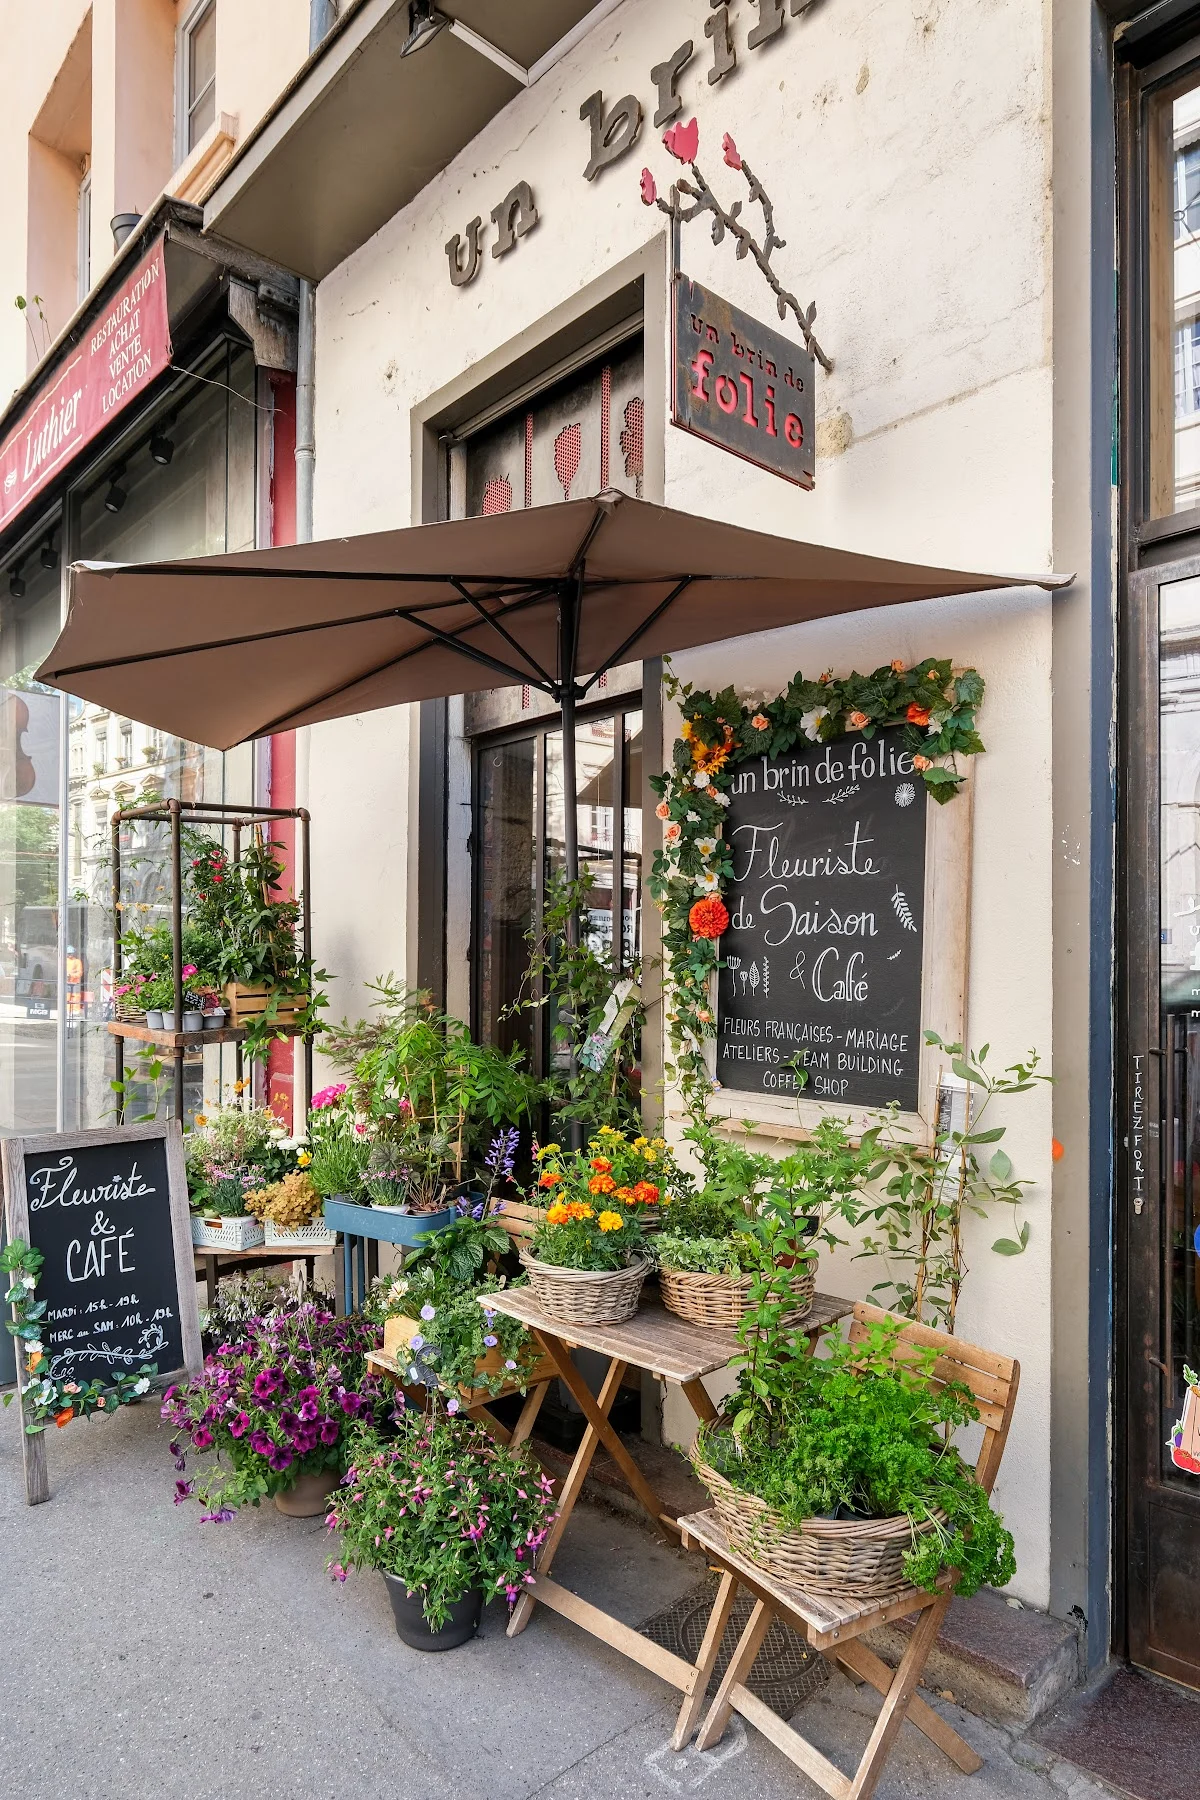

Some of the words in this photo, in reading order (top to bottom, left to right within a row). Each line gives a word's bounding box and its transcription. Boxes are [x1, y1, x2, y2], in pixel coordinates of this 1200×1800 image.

[445, 181, 539, 287] un
[90, 258, 160, 356] RESTAURATION
[109, 308, 140, 359] ACHAT
[109, 334, 141, 379] VENTE
[690, 313, 720, 344] un
[731, 332, 778, 378] brin
[784, 367, 804, 392] de
[102, 349, 152, 414] LOCATION
[691, 349, 804, 448] folie
[23, 388, 82, 482] Luthier
[730, 771, 756, 795] un
[761, 756, 810, 790] brin
[815, 747, 844, 784] de
[848, 739, 915, 781] folie
[731, 821, 881, 882] Fleuriste
[732, 896, 756, 930] de
[760, 884, 878, 946] Saison
[789, 950, 806, 989] &
[812, 947, 869, 1002] Café
[723, 1043, 780, 1064] ATELIERS
[837, 1053, 904, 1076] BUILDING
[724, 1017, 760, 1037] FLEURS
[765, 1020, 833, 1043] FRANÇAISES
[845, 1029, 909, 1052] MARIAGE
[814, 1075, 849, 1096] SHOP
[1132, 1055, 1144, 1130] TIREZ
[29, 1156, 156, 1212] Fleuriste
[1132, 1134, 1145, 1191] FORT
[90, 1211, 116, 1236] &
[66, 1227, 136, 1282] CAFÉ
[47, 1305, 77, 1321] MARDI
[85, 1299, 108, 1314] 15h
[115, 1293, 140, 1307] 19h
[49, 1328, 74, 1343] MERC
[93, 1320, 114, 1334] SAM
[121, 1312, 144, 1328] 10h
[151, 1307, 174, 1322] 19h
